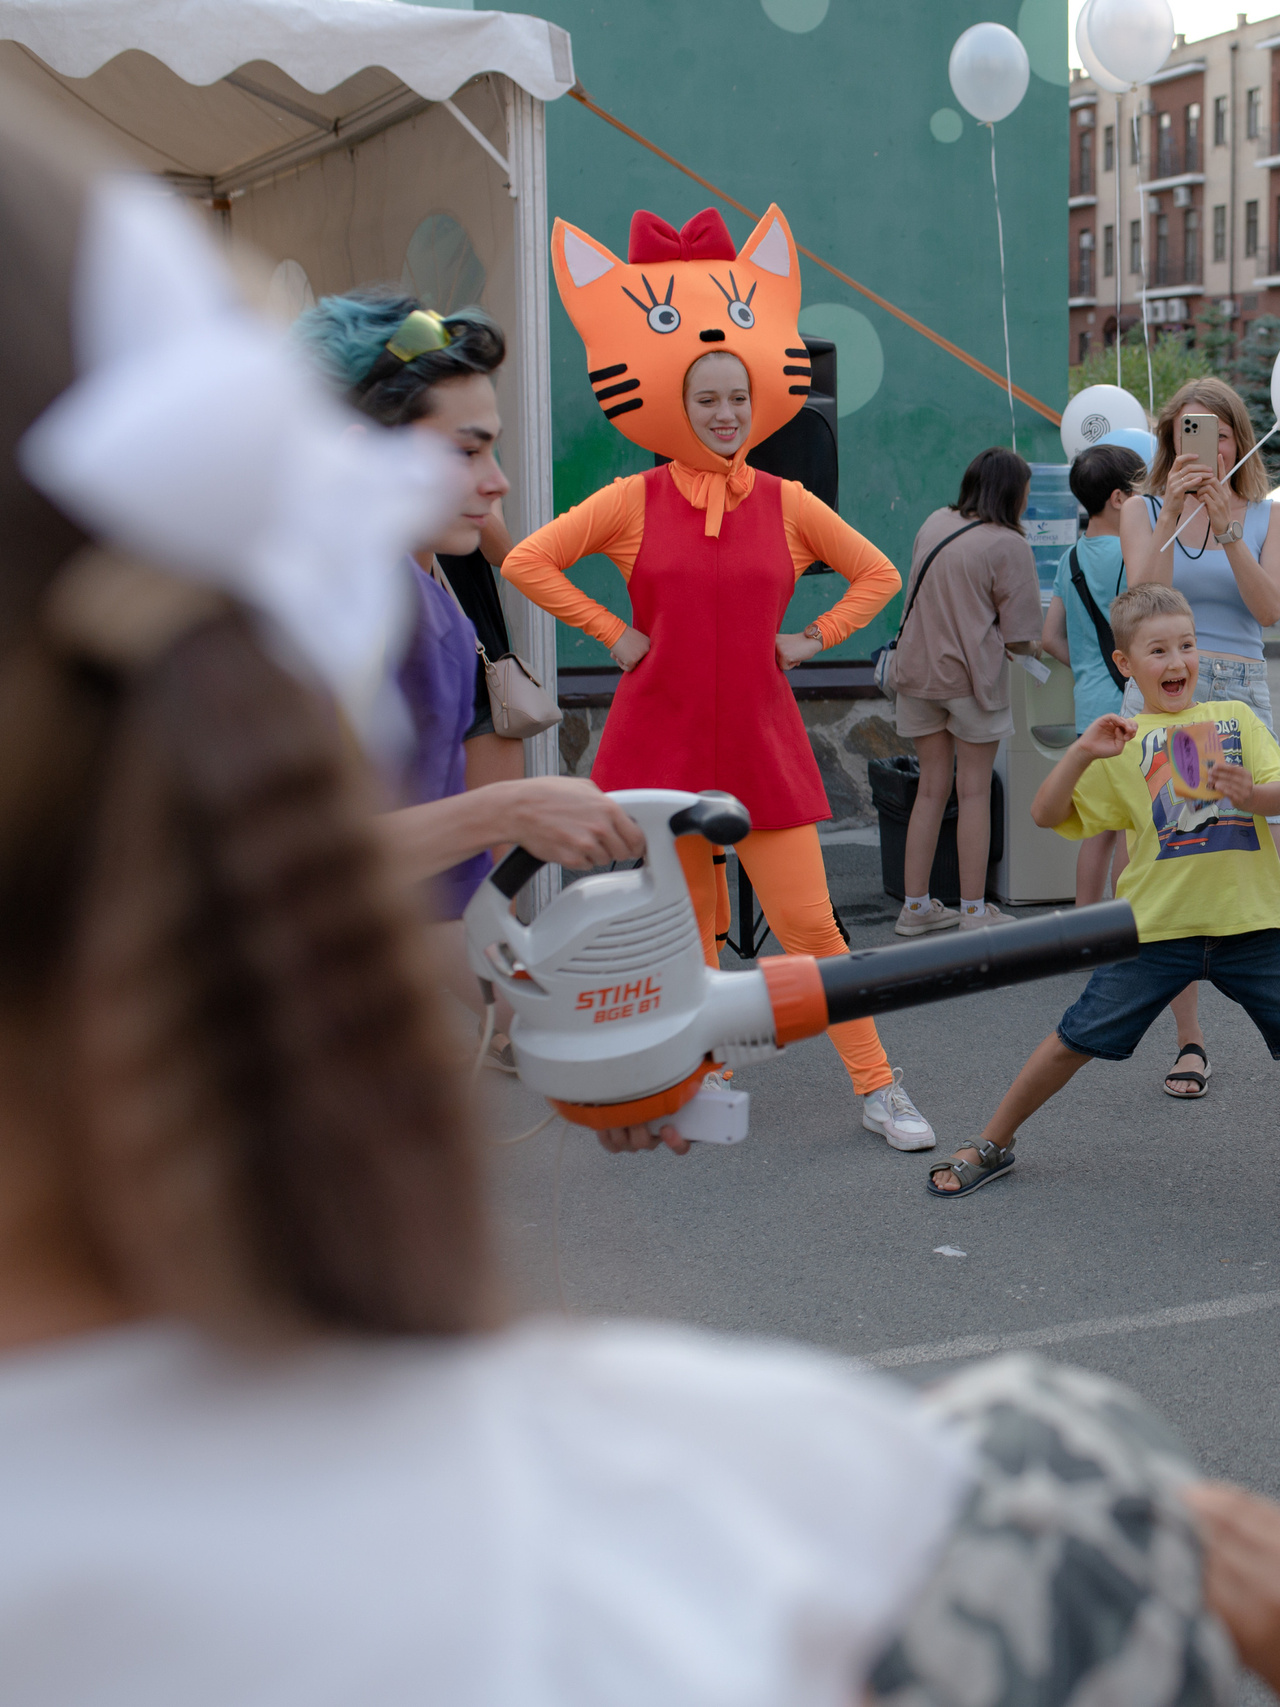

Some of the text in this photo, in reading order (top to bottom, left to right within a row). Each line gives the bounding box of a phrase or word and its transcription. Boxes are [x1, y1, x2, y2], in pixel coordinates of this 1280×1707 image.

[574, 976, 663, 1011] STIHL
[592, 995, 662, 1025] BGE 81
